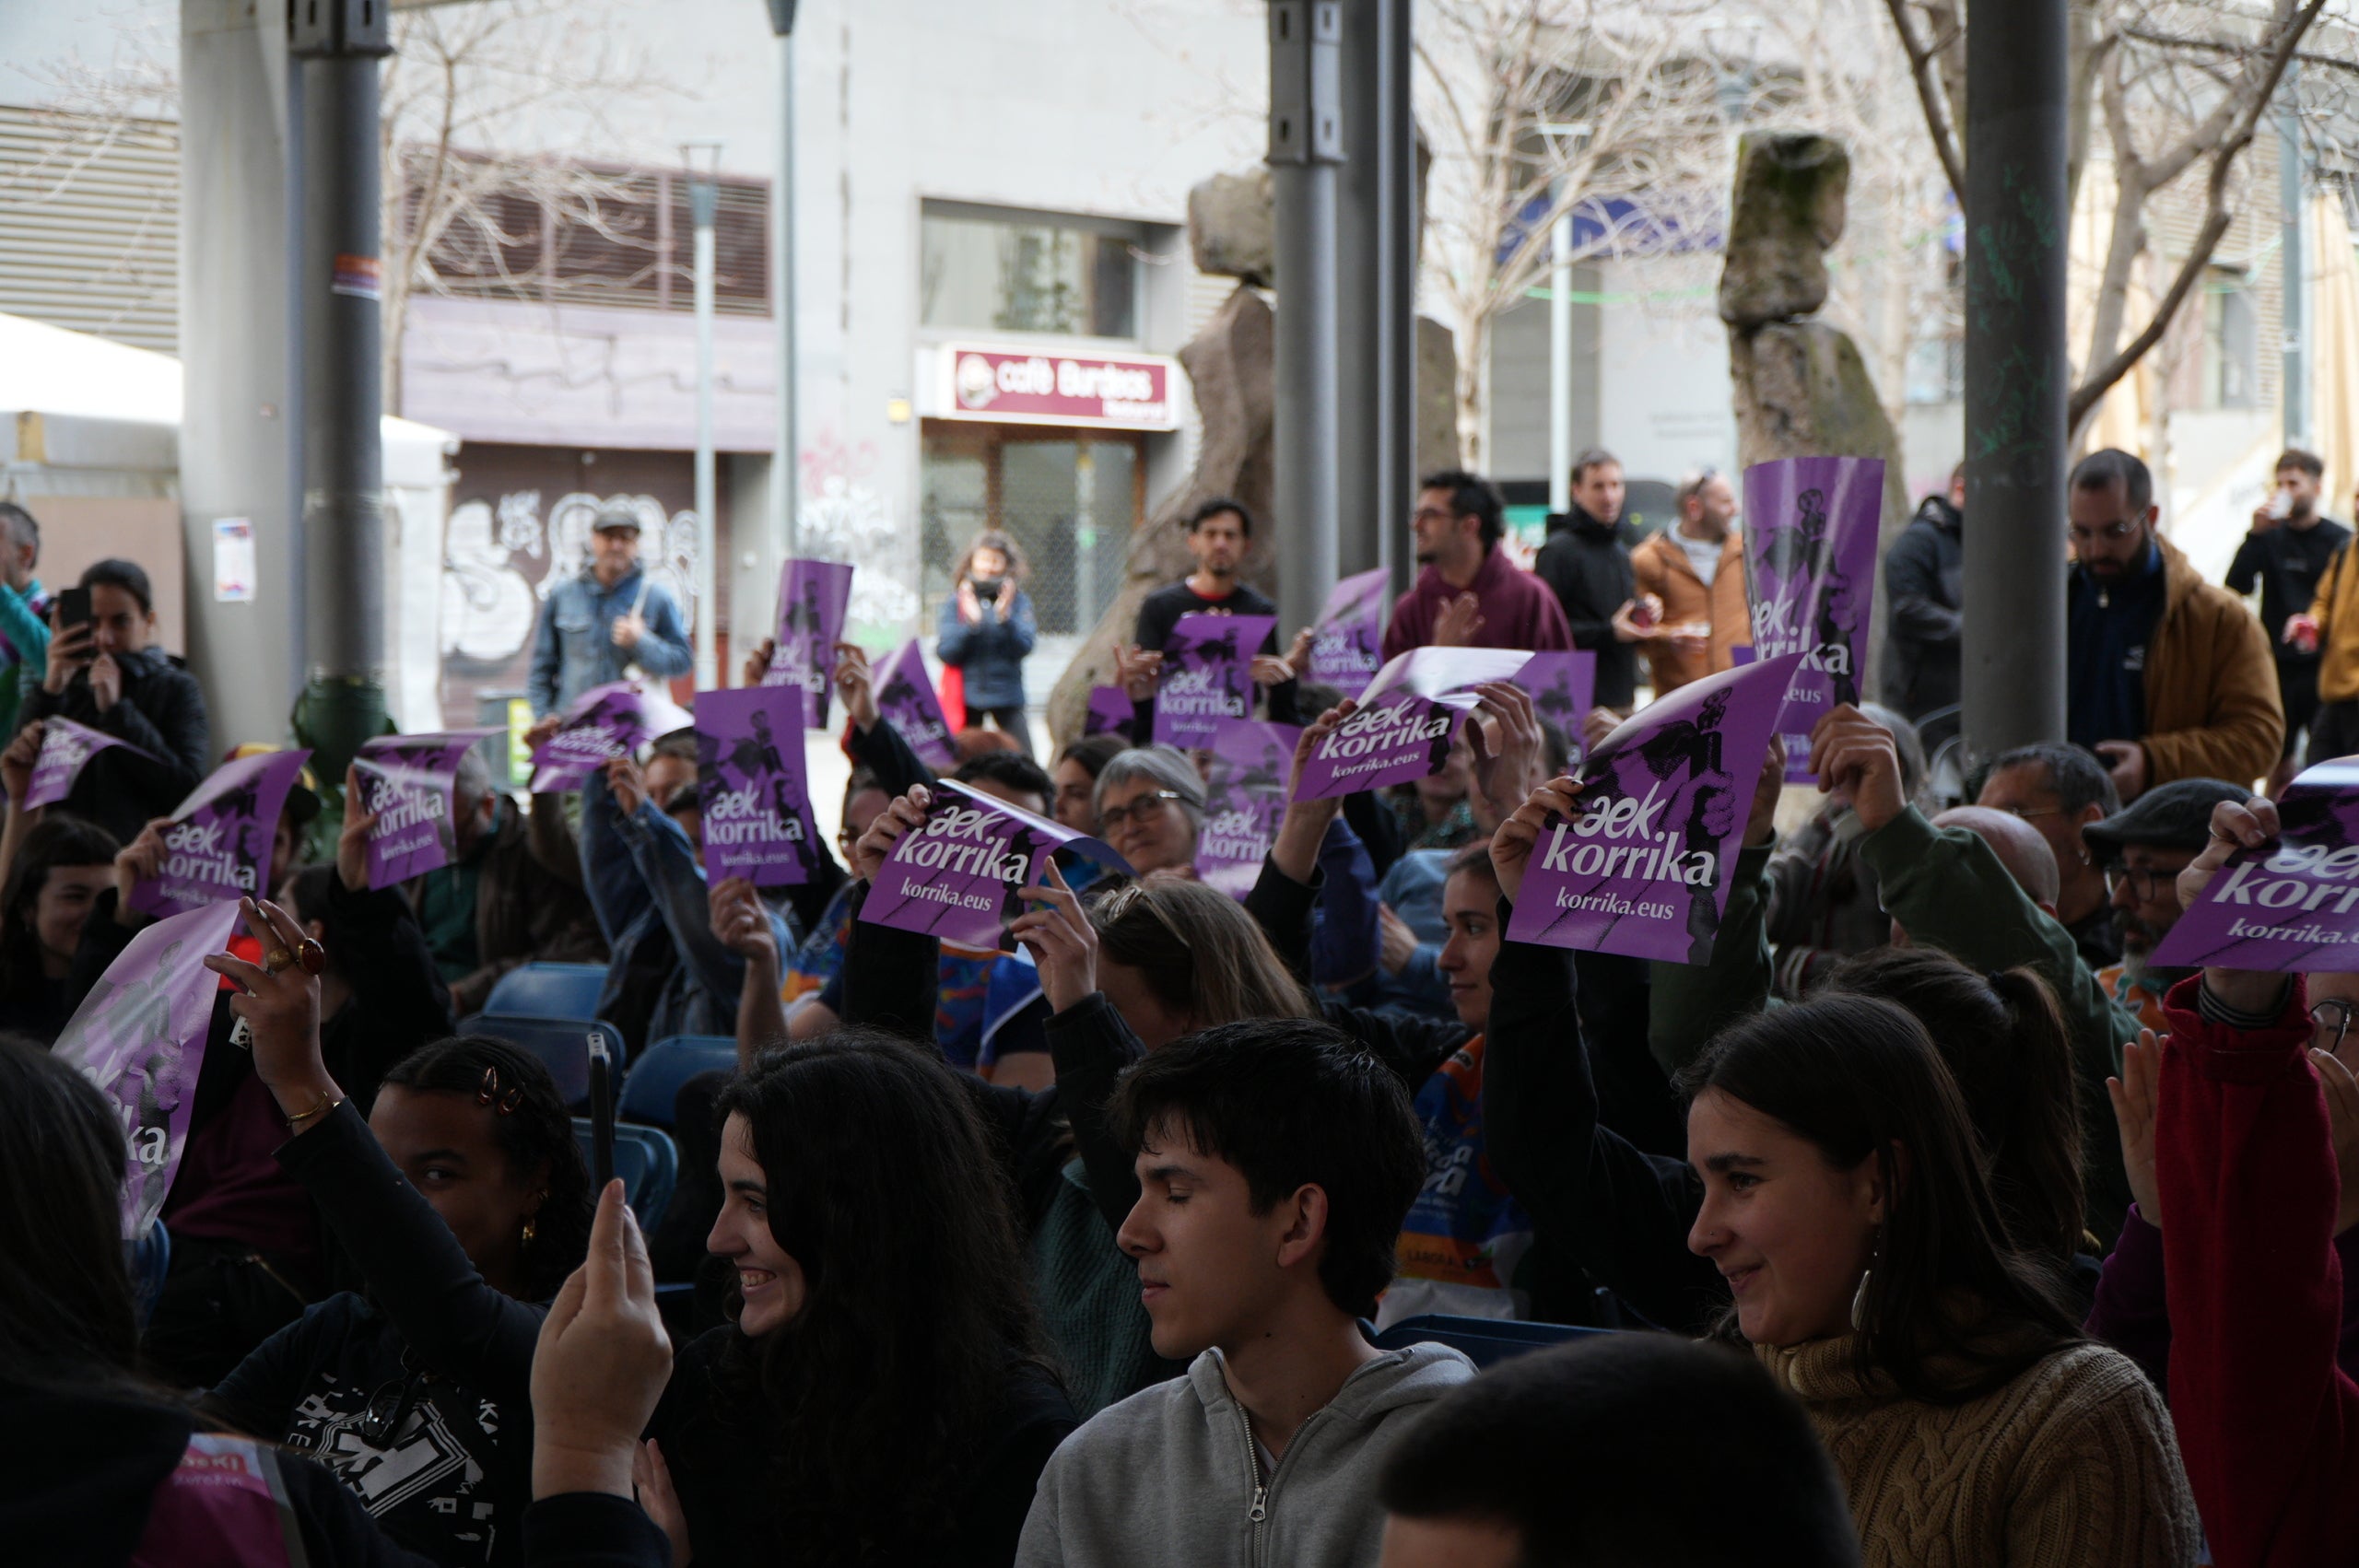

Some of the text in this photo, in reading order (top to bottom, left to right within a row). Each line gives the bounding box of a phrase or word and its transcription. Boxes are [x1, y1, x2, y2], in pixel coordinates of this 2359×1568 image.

[1755, 626, 1850, 675] rrika
[1339, 696, 1415, 737] aek
[1318, 715, 1451, 760] korrika
[1331, 751, 1420, 778] korrika.eus
[710, 778, 762, 820] aek
[1573, 781, 1666, 840] aek
[165, 818, 224, 858] aek
[703, 808, 804, 846] korrika
[925, 805, 1006, 842] aek
[1213, 802, 1260, 838] aek
[158, 851, 256, 891] orrika
[894, 827, 1029, 884] korrika
[1541, 823, 1715, 887] korrika
[2263, 844, 2359, 880] ae
[900, 877, 992, 912] korrika.eus
[1555, 886, 1674, 919] korrika.eus
[2212, 861, 2359, 914] korr
